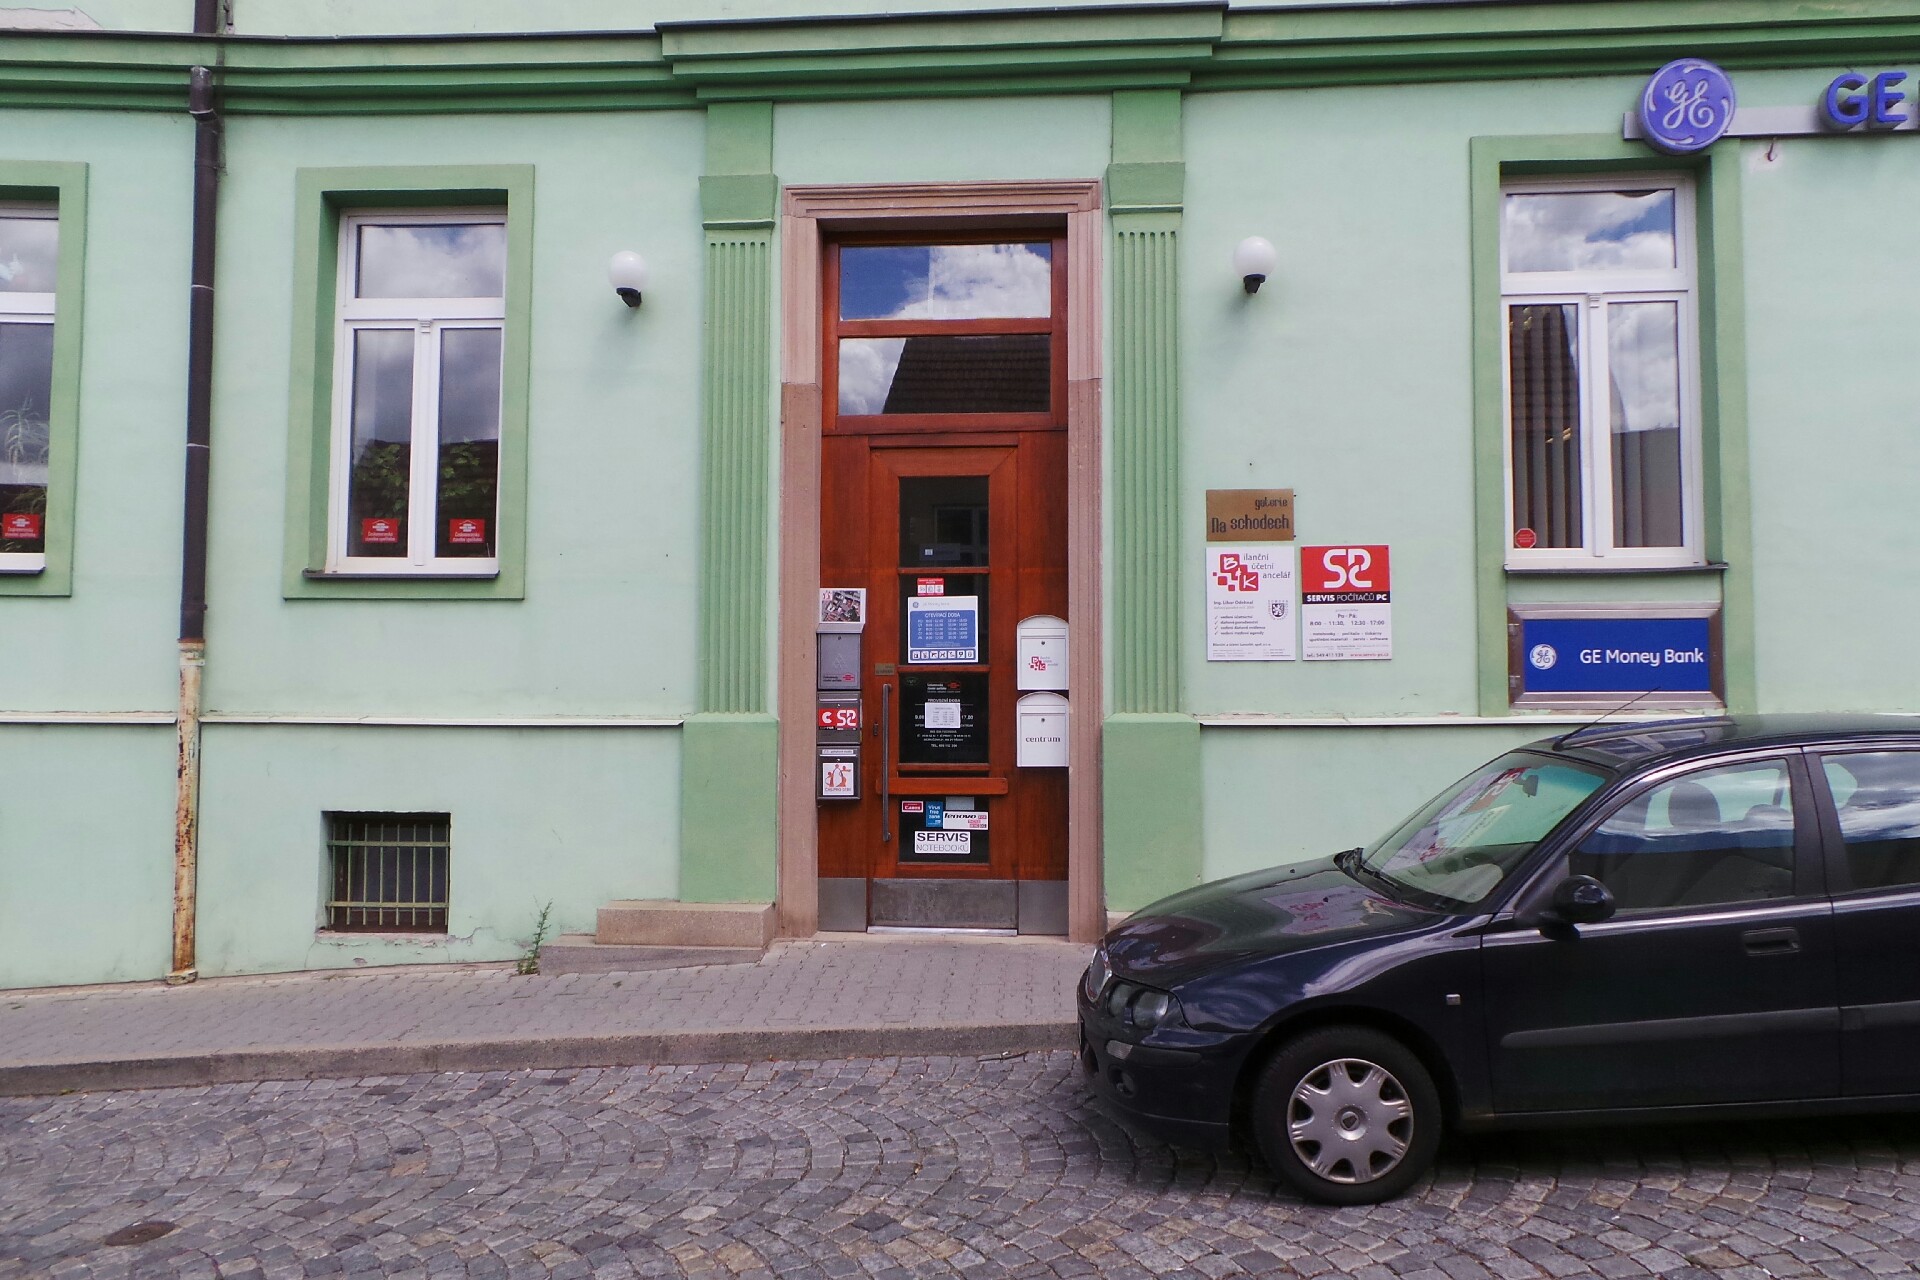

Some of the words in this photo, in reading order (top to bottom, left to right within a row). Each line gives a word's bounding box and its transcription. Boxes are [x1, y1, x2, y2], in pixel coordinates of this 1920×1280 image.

[1823, 71, 1908, 128] GE
[1255, 496, 1288, 511] galerie
[1230, 514, 1290, 530] schodech
[1306, 594, 1336, 602] SERVIS
[1579, 650, 1602, 664] GE
[1606, 650, 1660, 667] Money
[1664, 648, 1704, 664] Bank
[916, 832, 969, 842] SERVIS
[916, 843, 969, 852] NOTEBOOKŮ
